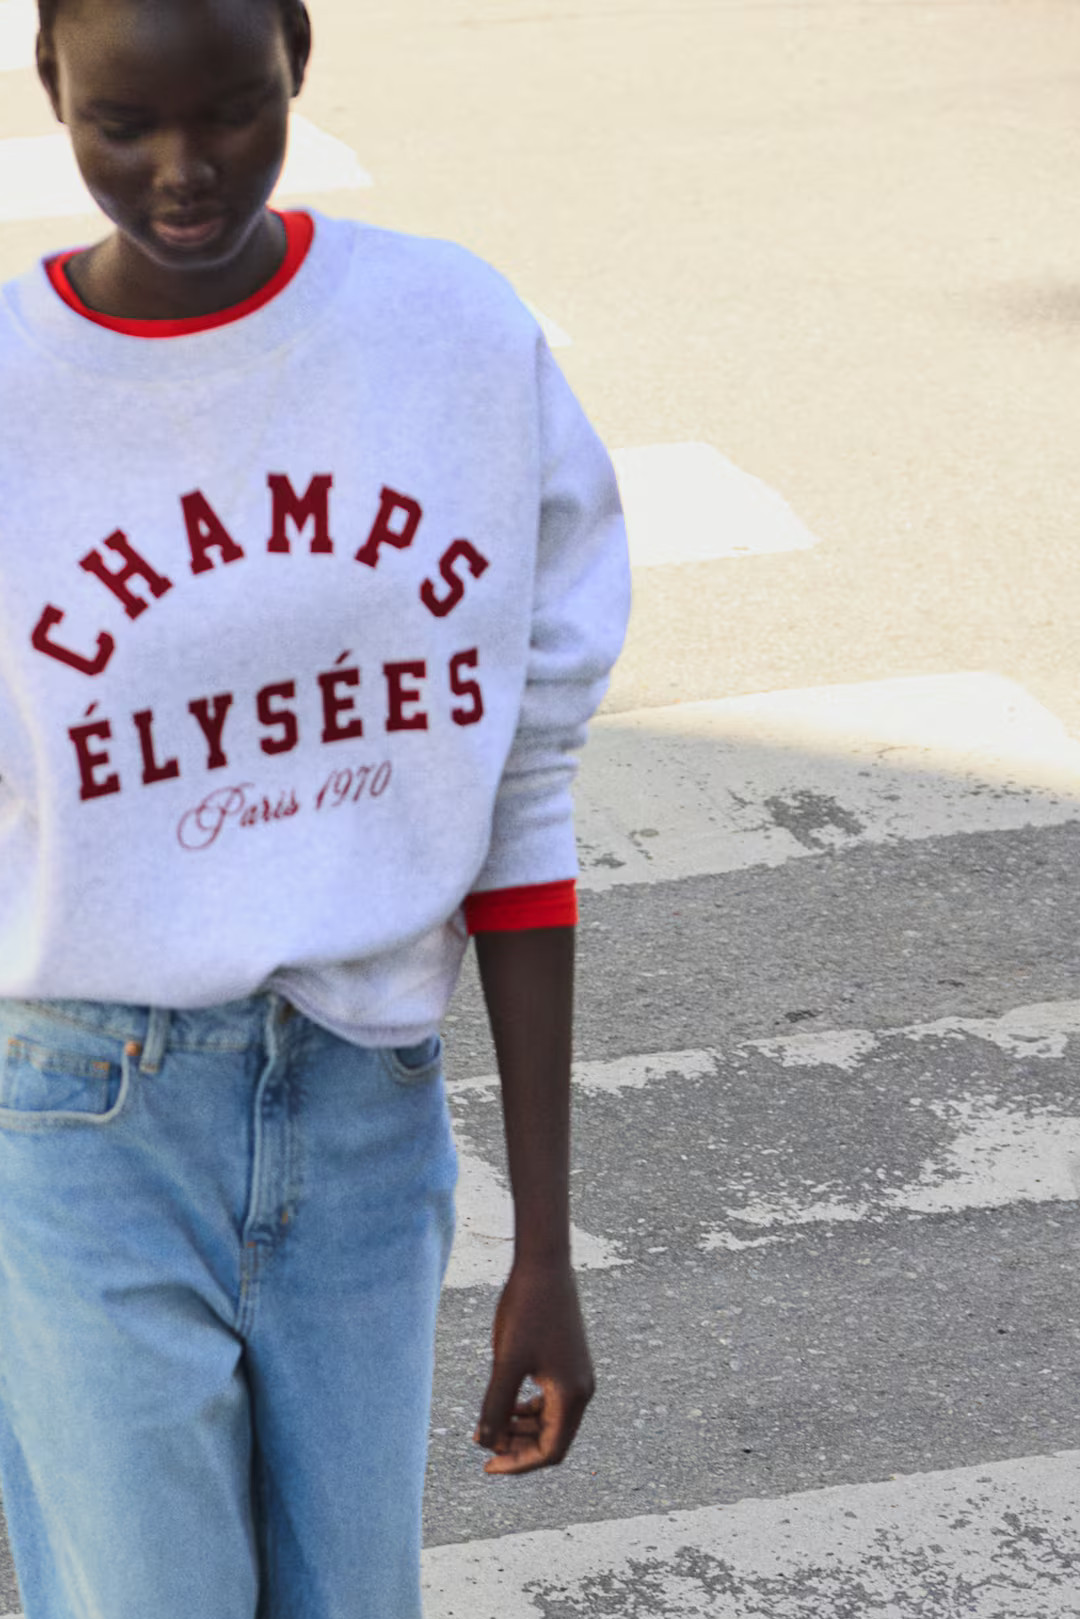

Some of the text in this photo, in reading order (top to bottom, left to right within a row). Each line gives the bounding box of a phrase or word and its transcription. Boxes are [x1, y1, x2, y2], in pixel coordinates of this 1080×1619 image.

[31, 472, 490, 677] CHAMPS
[67, 648, 484, 801] ÉLYSÉES
[176, 760, 392, 851] Paris 1970
